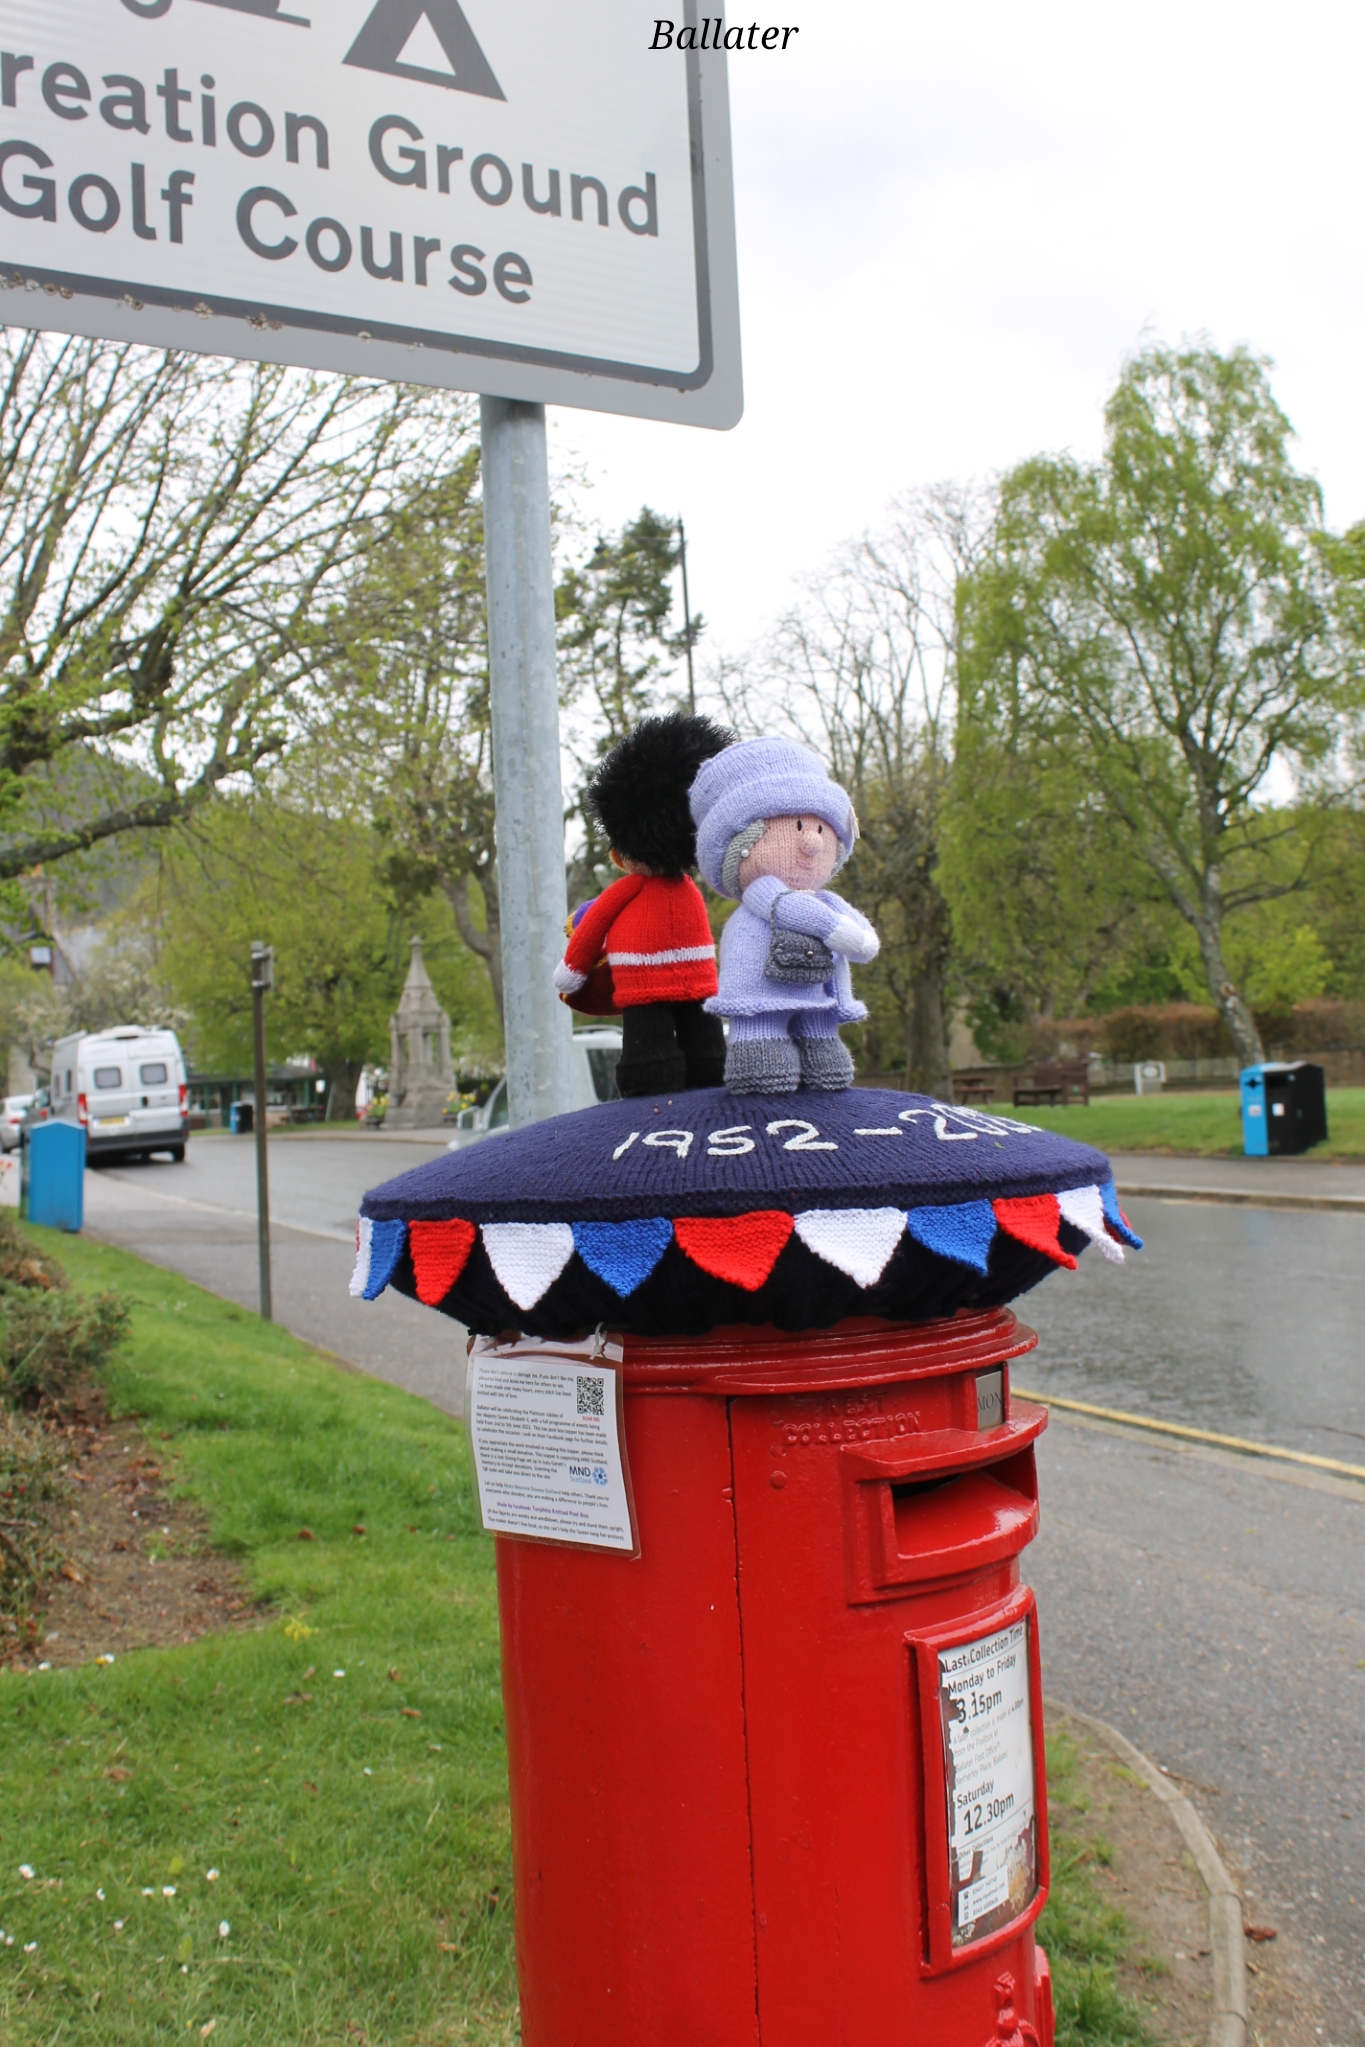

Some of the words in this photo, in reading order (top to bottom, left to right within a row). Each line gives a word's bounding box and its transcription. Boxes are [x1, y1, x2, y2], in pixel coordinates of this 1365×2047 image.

[1, 51, 329, 170] reation
[368, 115, 659, 237] Ground
[0, 140, 195, 244] Golf
[236, 186, 533, 304] Course
[826, 1392, 886, 1417] NEXT
[978, 1392, 1001, 1411] MON
[783, 1411, 920, 1444] COLLECTION
[570, 1465, 590, 1476] MND
[570, 1476, 591, 1484] Scotland
[945, 1654, 967, 1673] Last
[970, 1638, 1008, 1663] Collection
[948, 1672, 984, 1696] Monday
[987, 1667, 994, 1679] to
[997, 1653, 1016, 1674] Friday
[955, 1690, 1002, 1723] 3.15pm
[957, 1779, 994, 1809] Saturday
[963, 1793, 1014, 1835] 12.30pm
